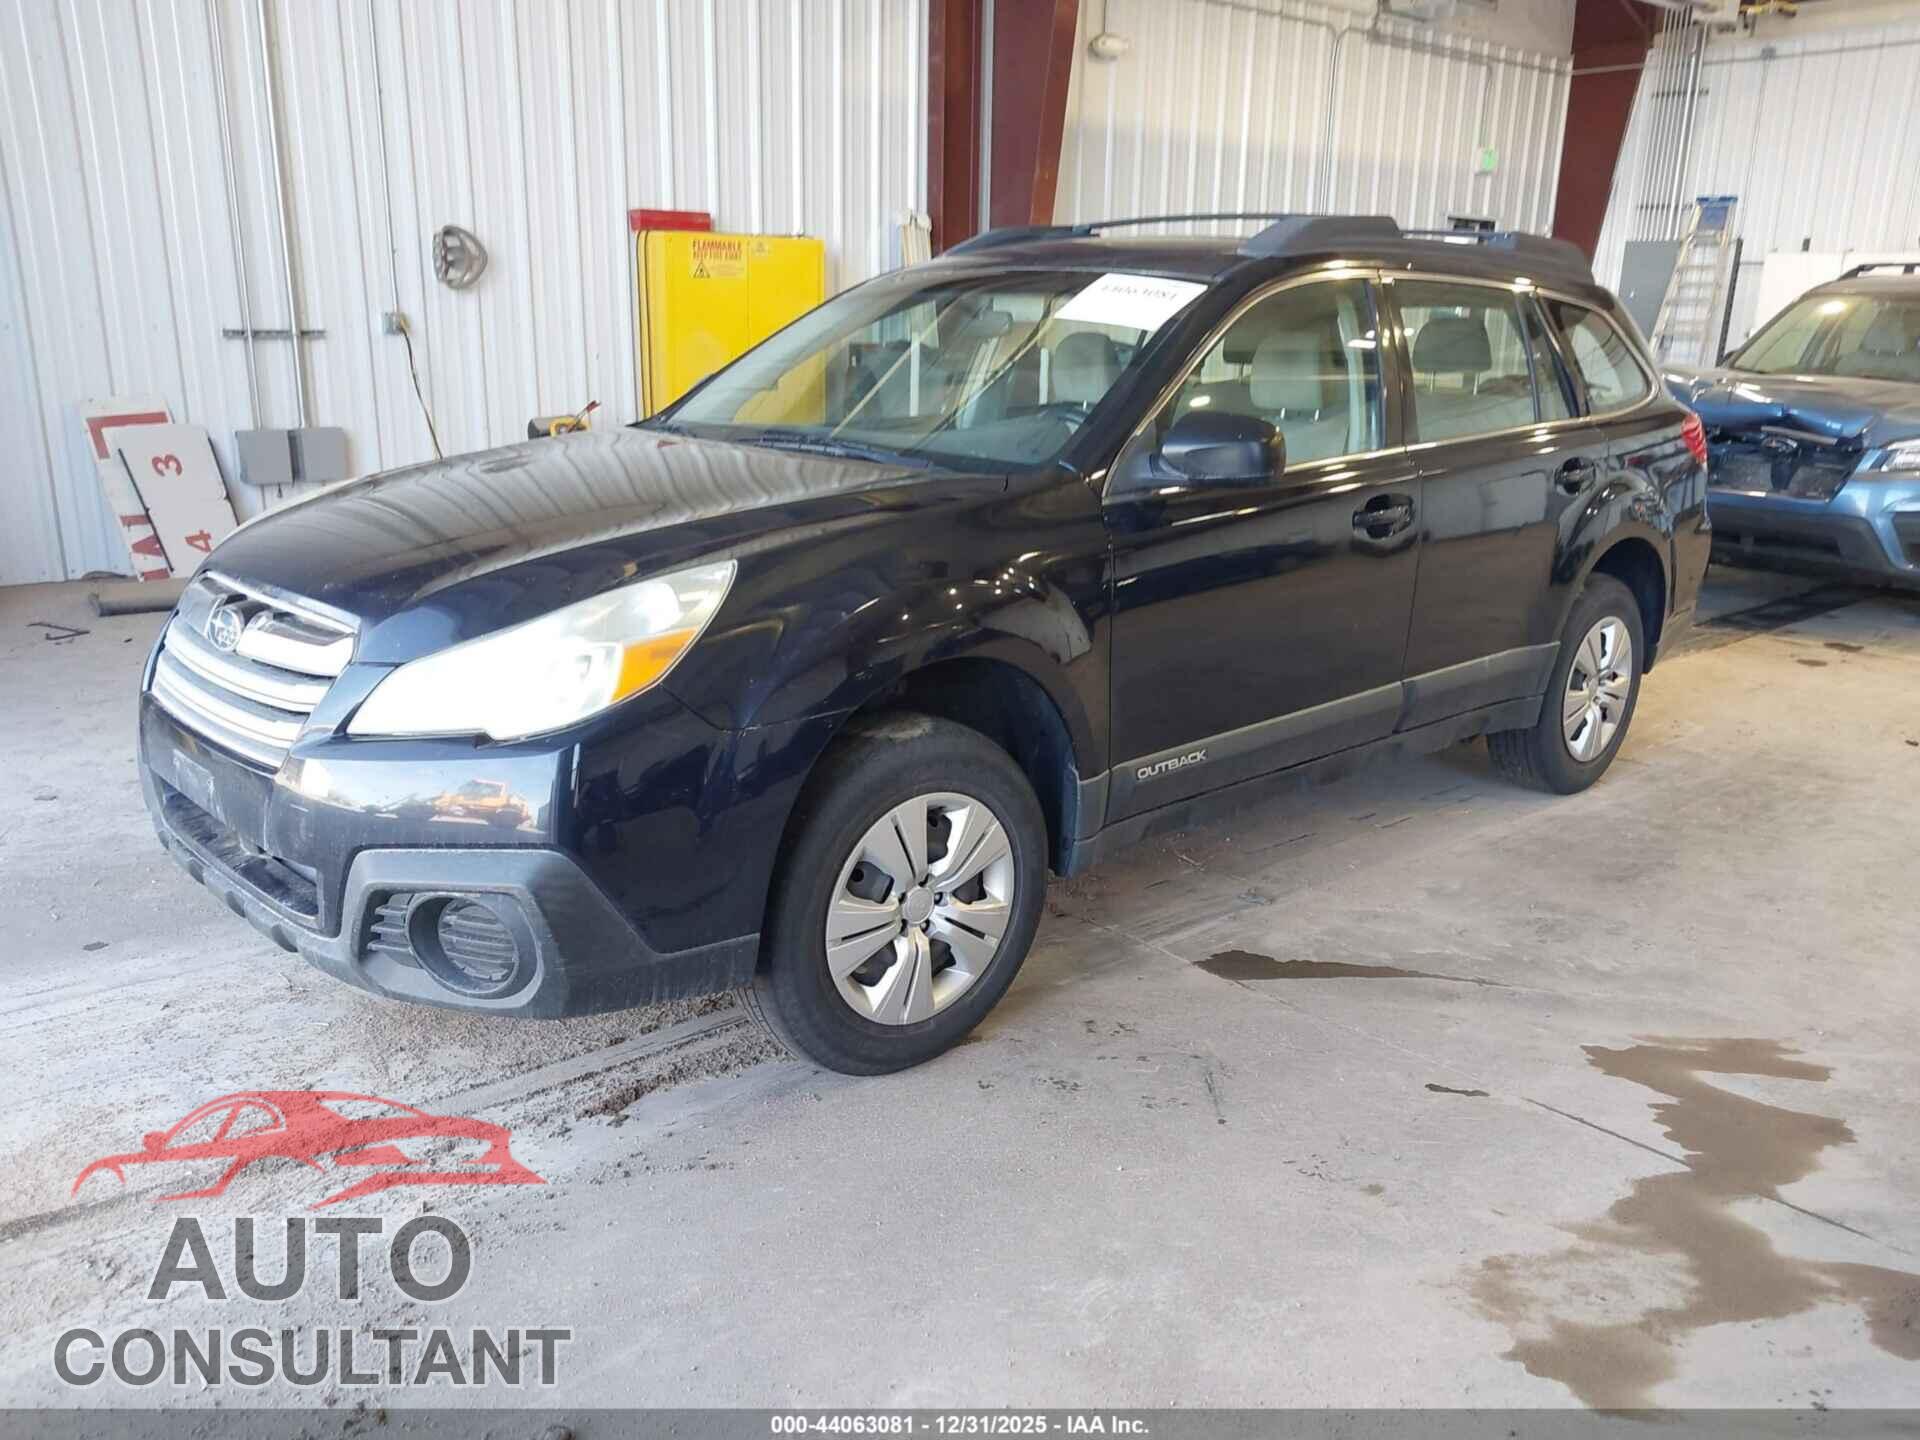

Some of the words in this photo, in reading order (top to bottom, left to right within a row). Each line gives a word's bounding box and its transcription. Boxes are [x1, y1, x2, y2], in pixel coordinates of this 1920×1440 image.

[692, 240, 742, 251] FLAMMABLE
[151, 454, 183, 477] 3
[185, 530, 212, 553] 4
[1137, 749, 1207, 780] OUTBACK
